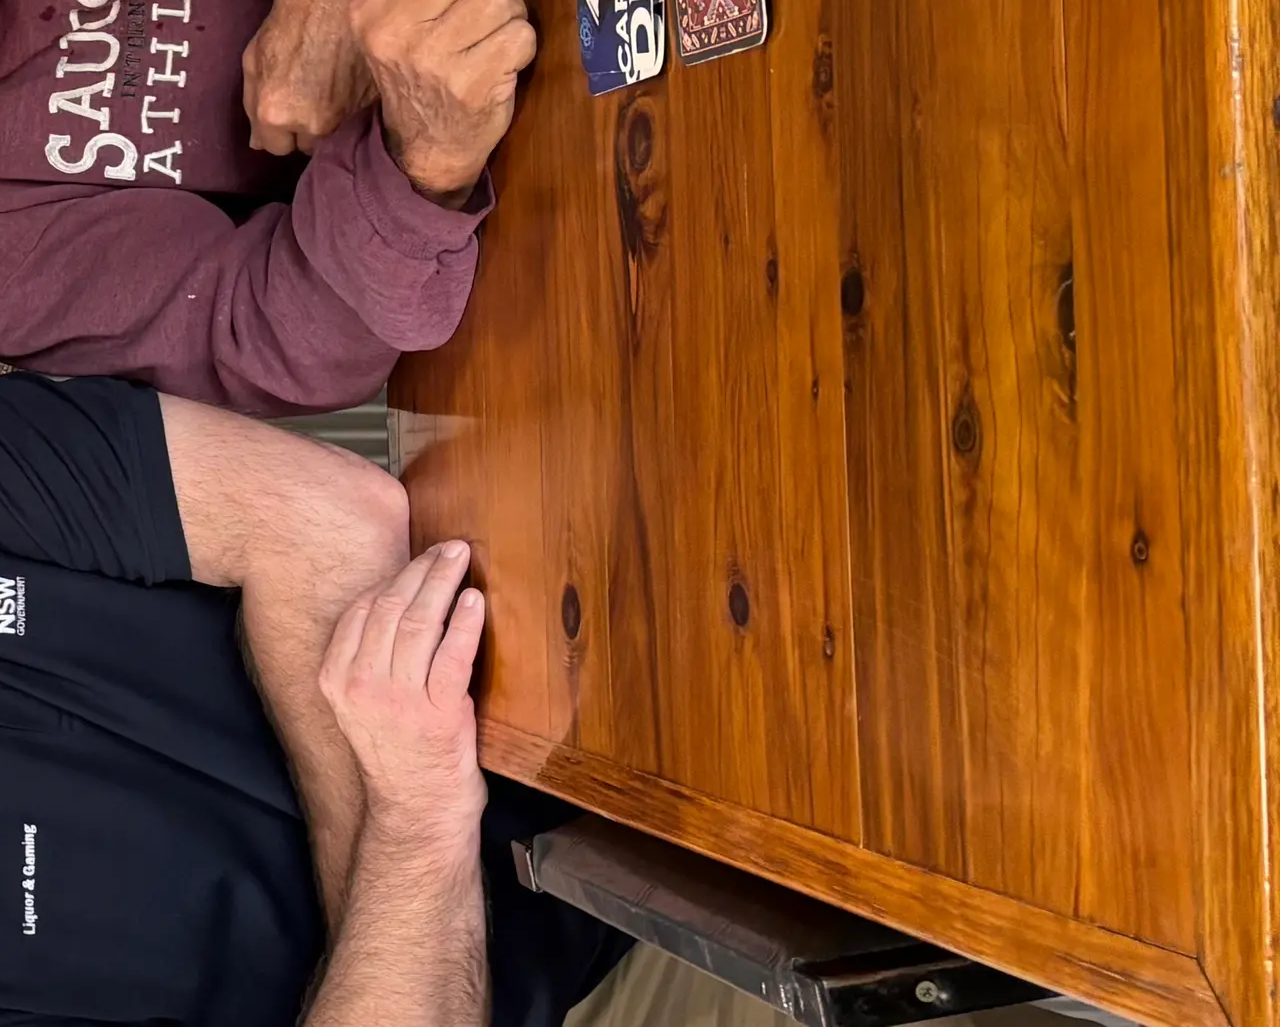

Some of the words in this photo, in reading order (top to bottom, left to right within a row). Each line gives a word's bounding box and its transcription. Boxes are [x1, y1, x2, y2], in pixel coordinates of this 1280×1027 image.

[16, 576, 27, 636] GOVERNMENT
[21, 823, 39, 876] Gaming
[21, 878, 35, 889] &
[20, 890, 39, 936] Liquor
